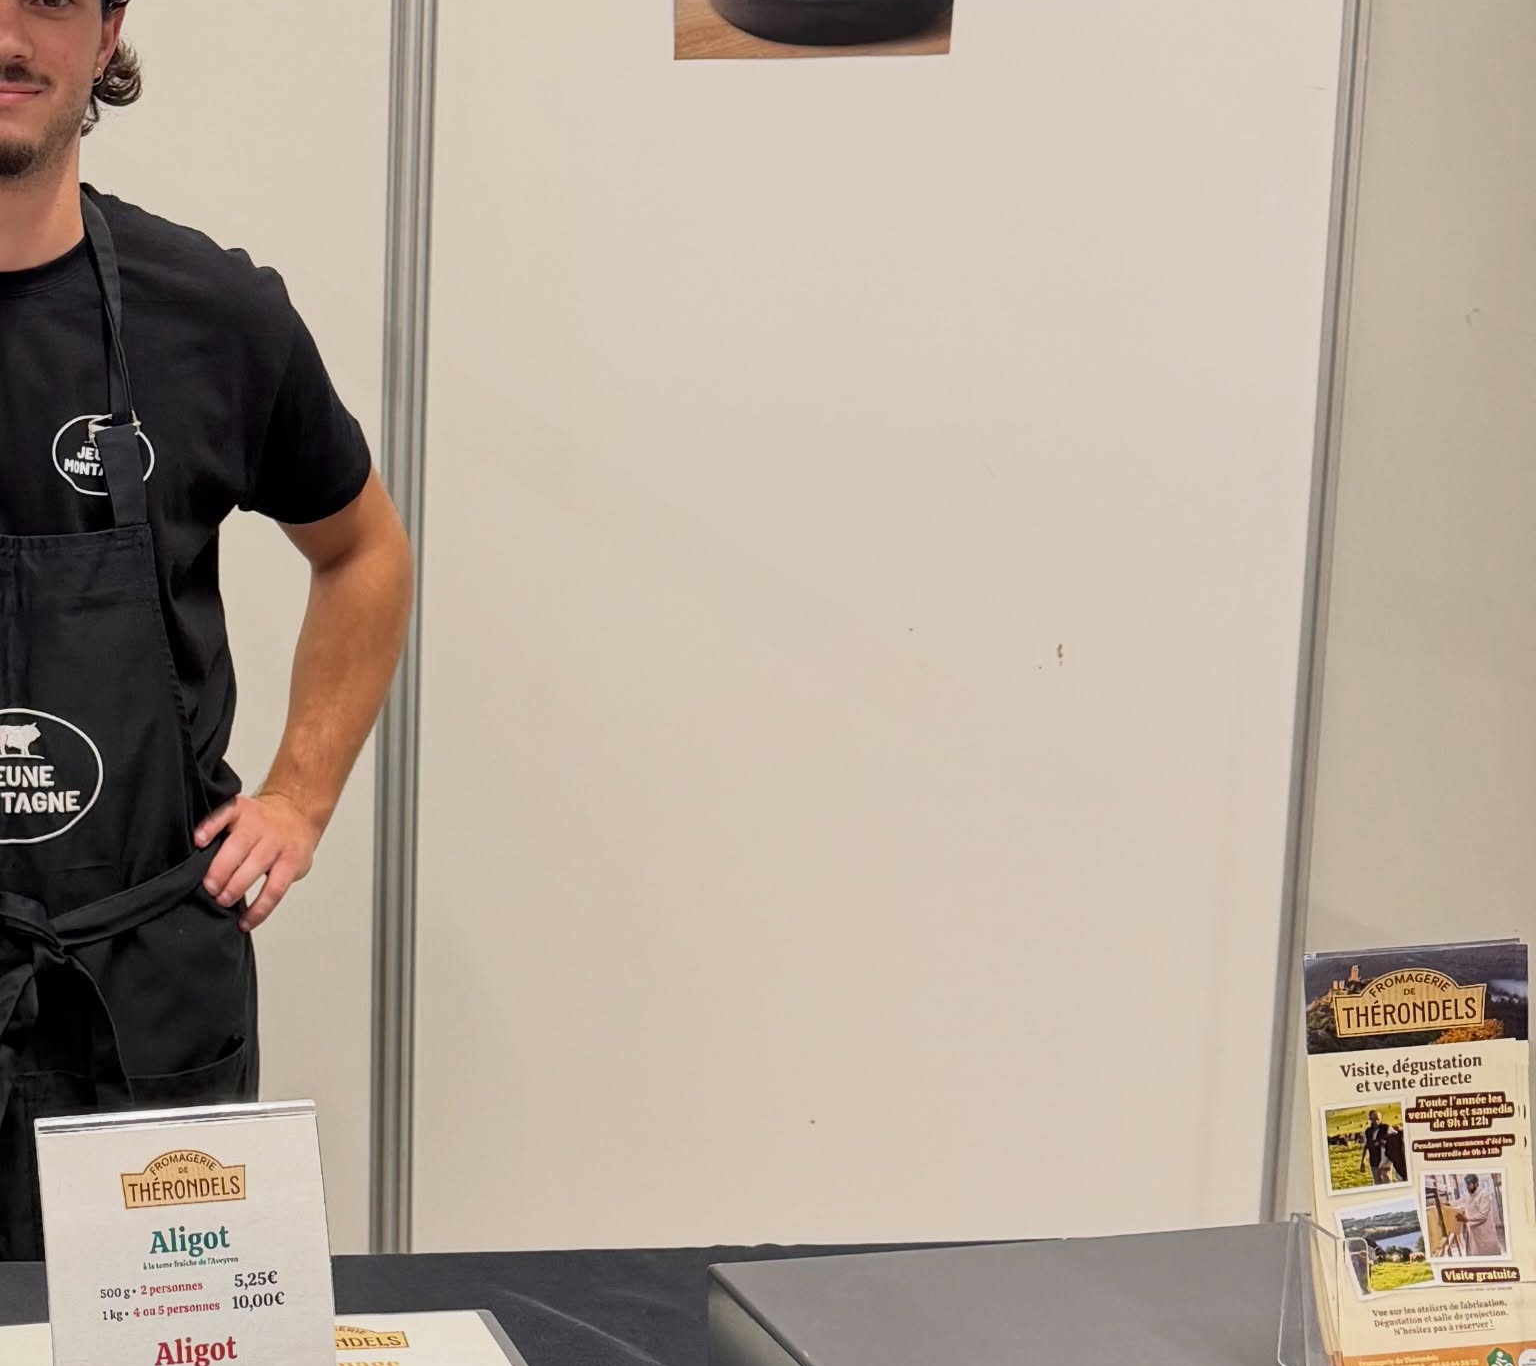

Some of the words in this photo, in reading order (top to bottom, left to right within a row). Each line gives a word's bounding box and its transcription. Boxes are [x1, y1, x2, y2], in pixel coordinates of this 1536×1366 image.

[1369, 973, 1452, 998] FROMAGERIE
[1403, 987, 1416, 996] DE
[1342, 997, 1477, 1029] THÉRONDELS
[1340, 1062, 1389, 1078] Visite,
[1393, 1054, 1482, 1075] dégustation
[1356, 1082, 1370, 1093] et
[1374, 1078, 1415, 1091] vente
[1419, 1071, 1472, 1088] directe
[1408, 1108, 1459, 1120] vendredis
[1460, 1107, 1469, 1116] et
[1471, 1104, 1513, 1116] samedis
[1418, 1099, 1447, 1108] Toute
[1449, 1095, 1486, 1106] l'année
[1488, 1094, 1502, 1103] les
[1433, 1119, 1445, 1129] de
[1447, 1117, 1461, 1128] 9h
[1463, 1117, 1469, 1127] à
[1471, 1116, 1489, 1127] 12h
[149, 1152, 217, 1175] FROMAGERIE
[178, 1166, 188, 1174] DE
[128, 1175, 241, 1203] THÉRONDELS
[149, 1225, 230, 1257] Aligot
[100, 1287, 122, 1299] 500
[124, 1290, 131, 1299] g
[140, 1285, 148, 1295] 2
[149, 1281, 203, 1298] personnes
[234, 1270, 278, 1290] 5,25€
[1444, 1270, 1474, 1281] Visite
[1475, 1269, 1517, 1282] gratuite
[102, 1310, 108, 1321] 1
[110, 1309, 123, 1322] kg
[133, 1307, 141, 1318] 4
[143, 1306, 156, 1316] ou
[158, 1305, 165, 1316] 5
[167, 1301, 220, 1318] personnes
[232, 1291, 285, 1312] 10,00€
[1404, 1306, 1416, 1314] les
[1449, 1303, 1459, 1311] de
